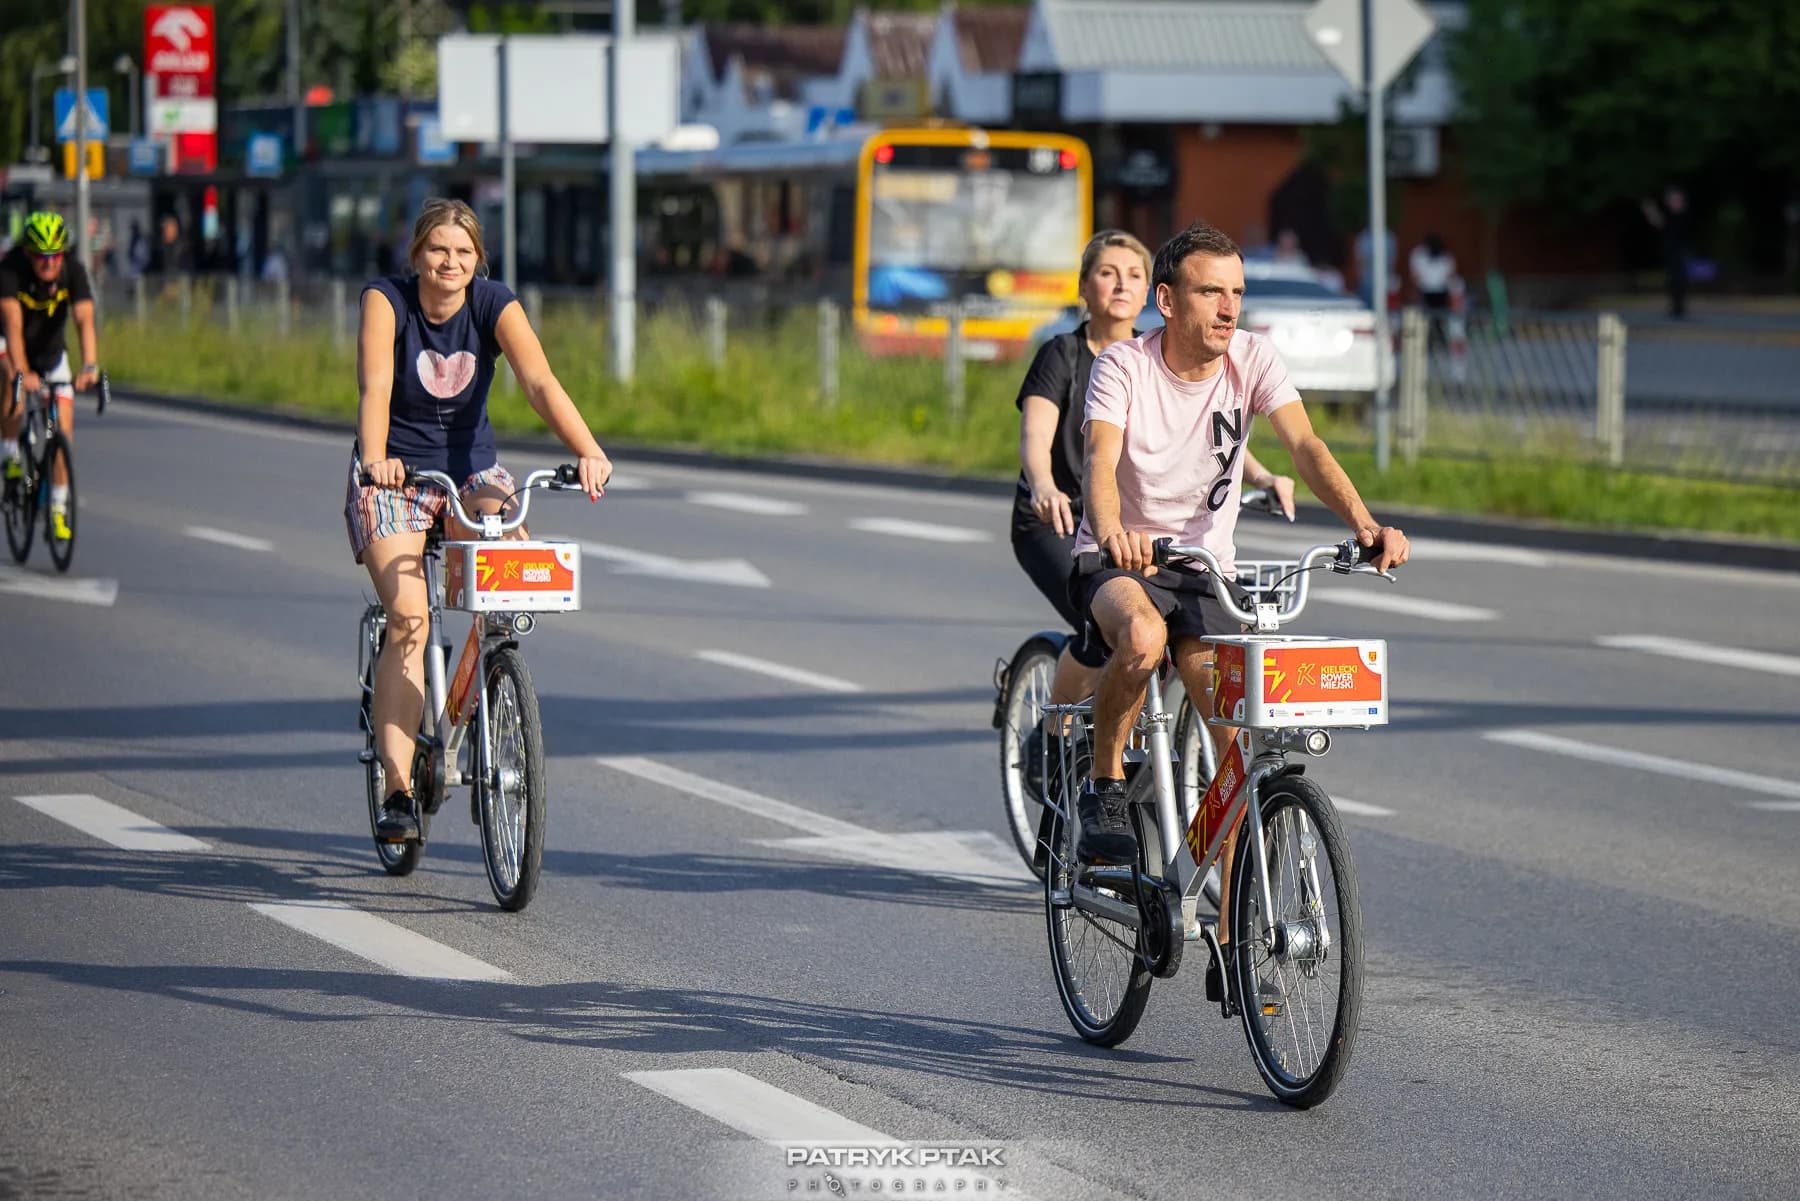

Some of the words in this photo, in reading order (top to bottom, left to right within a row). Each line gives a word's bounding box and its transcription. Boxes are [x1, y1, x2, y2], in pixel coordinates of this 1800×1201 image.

[1207, 408, 1242, 512] NYC
[1320, 665, 1358, 673] KIELECKI
[1320, 673, 1353, 682] ROWER
[1320, 681, 1354, 689] MIEJSKI
